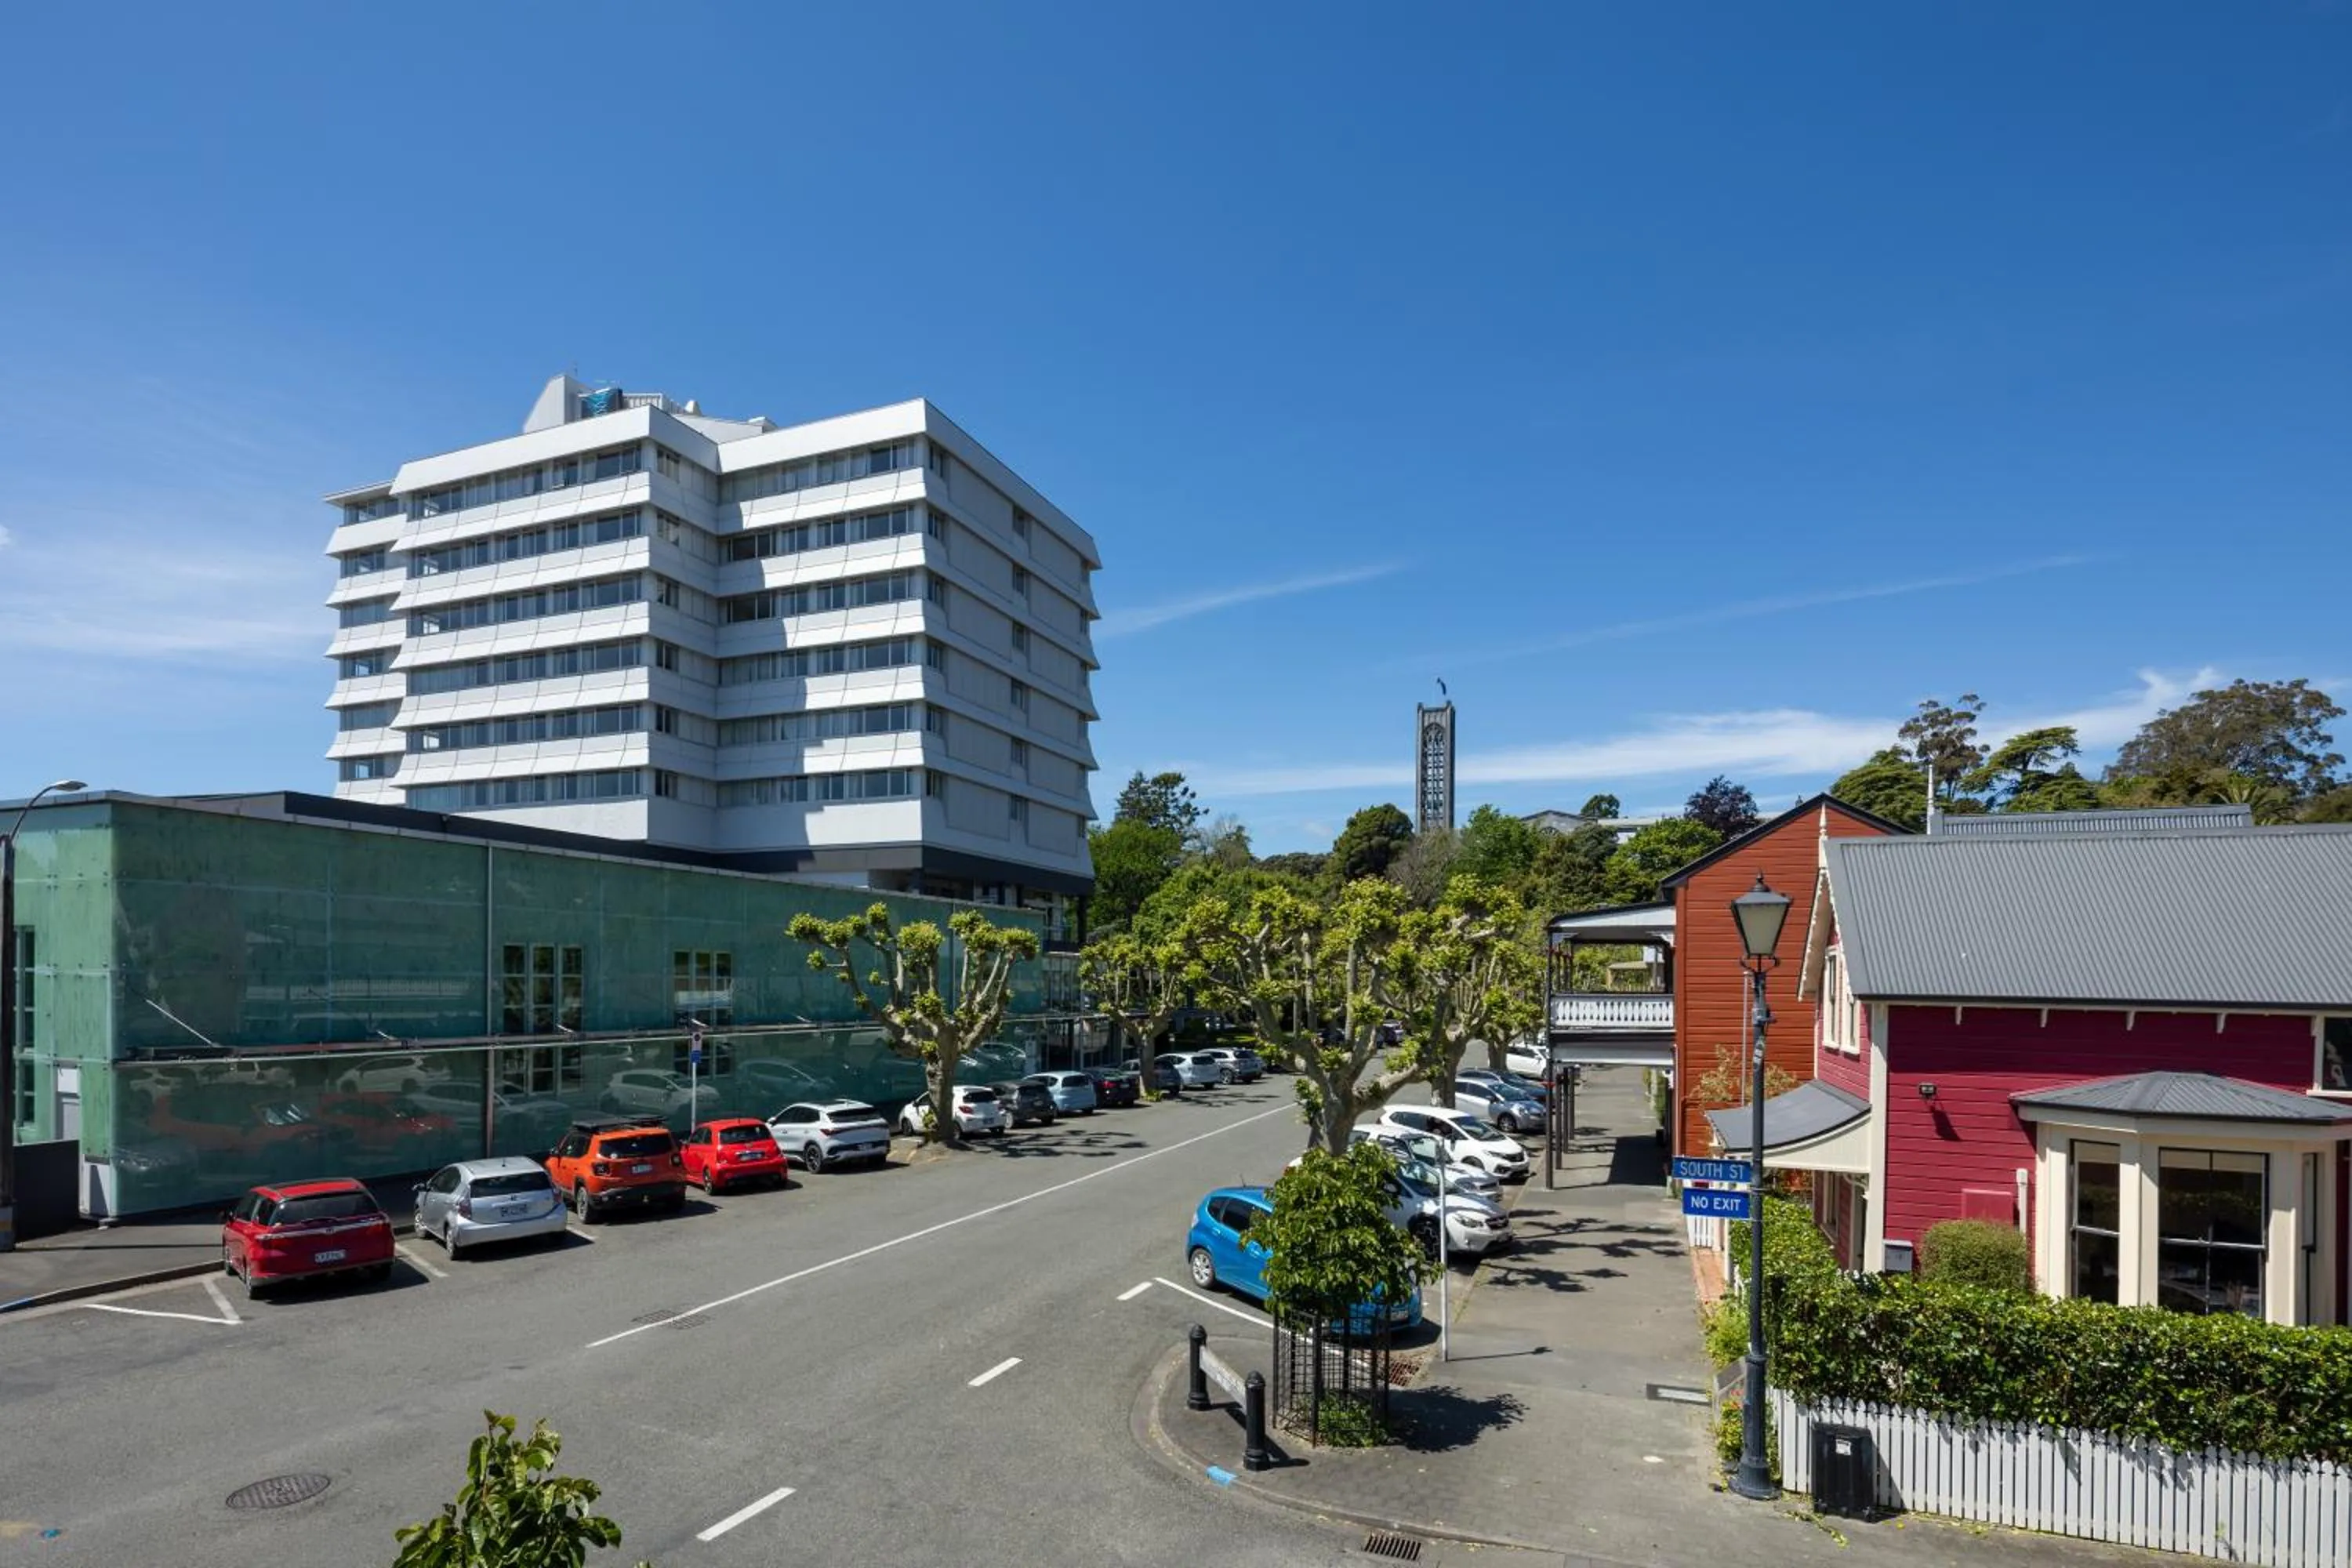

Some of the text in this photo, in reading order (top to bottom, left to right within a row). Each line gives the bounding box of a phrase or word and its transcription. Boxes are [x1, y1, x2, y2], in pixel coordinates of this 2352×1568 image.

[1680, 1161, 1744, 1180] SOUTH ST
[1691, 1196, 1740, 1211] NO EXIT
